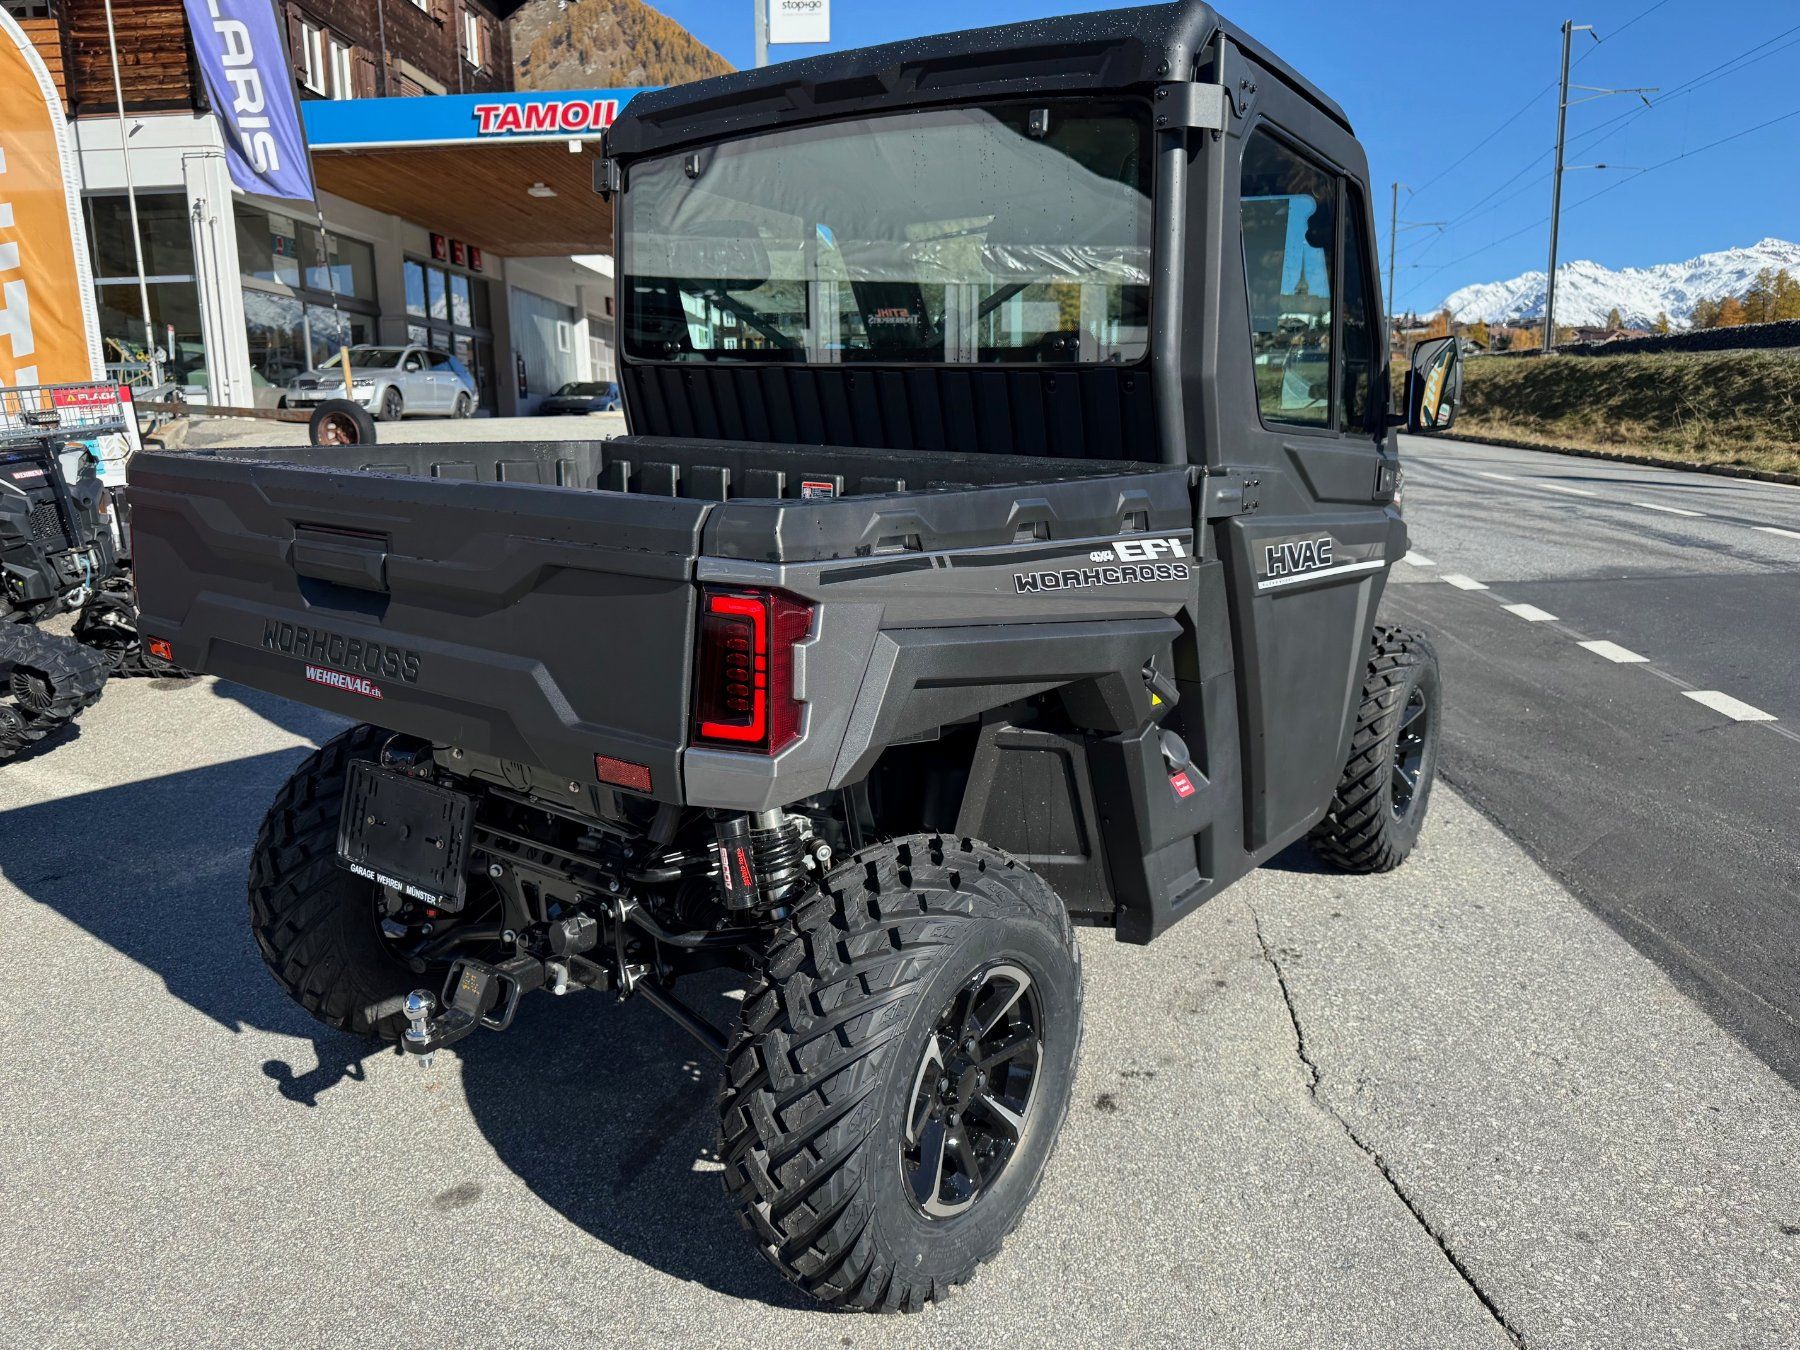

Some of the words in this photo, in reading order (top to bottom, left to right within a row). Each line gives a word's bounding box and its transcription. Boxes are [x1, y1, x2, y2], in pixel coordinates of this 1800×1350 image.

[475, 99, 618, 133] TAMOIL
[1112, 538, 1187, 562] EFI
[1265, 537, 1332, 577] HVAC
[1013, 563, 1189, 594] WORKCROSS
[262, 618, 421, 684] WORKCROSS
[306, 666, 382, 698] WEHRENAG.ch
[350, 863, 375, 880] GARAGE
[376, 873, 403, 890] WEHREN
[406, 885, 436, 905] MÜNSTER
